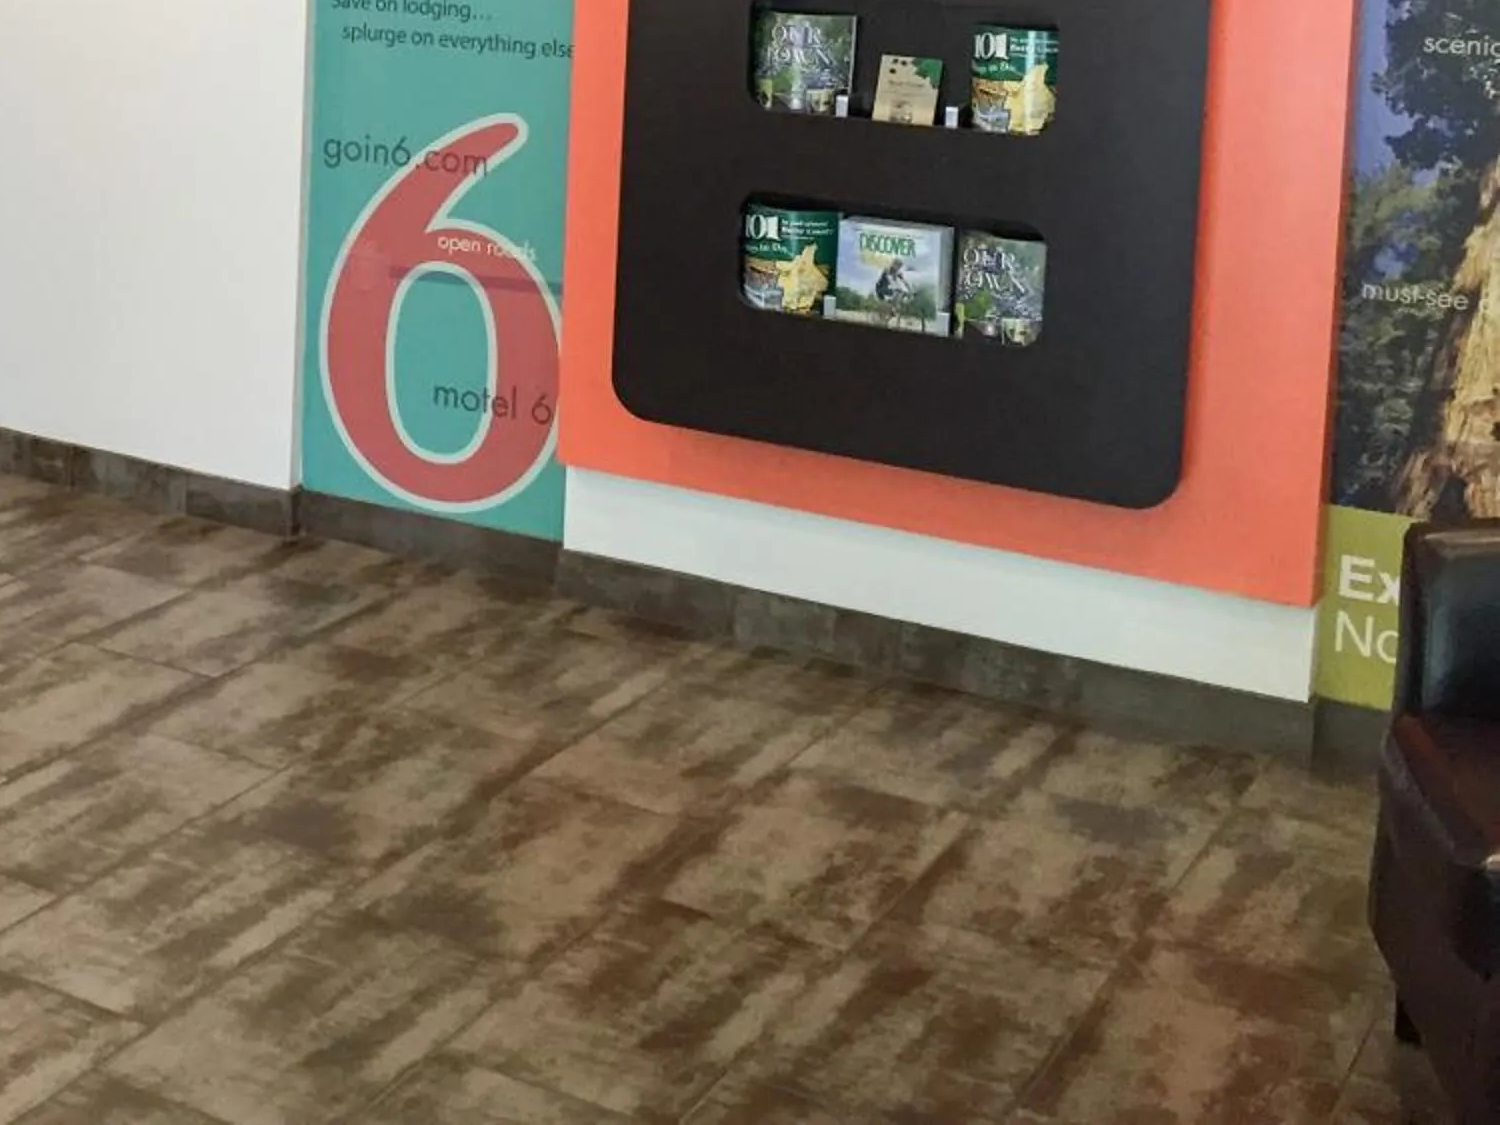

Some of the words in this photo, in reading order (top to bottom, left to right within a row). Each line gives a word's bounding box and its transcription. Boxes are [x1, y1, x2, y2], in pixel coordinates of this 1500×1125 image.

[342, 22, 407, 48] splurge
[411, 31, 434, 46] on
[438, 32, 536, 60] everything
[974, 32, 1009, 60] 101
[323, 134, 487, 175] goin6.com
[437, 235, 481, 255] open
[487, 240, 536, 261] rods
[860, 233, 916, 259] DISCOVER
[318, 112, 561, 514] 6
[1361, 281, 1469, 311] must-see
[433, 384, 518, 420] motel
[531, 392, 552, 426] 6
